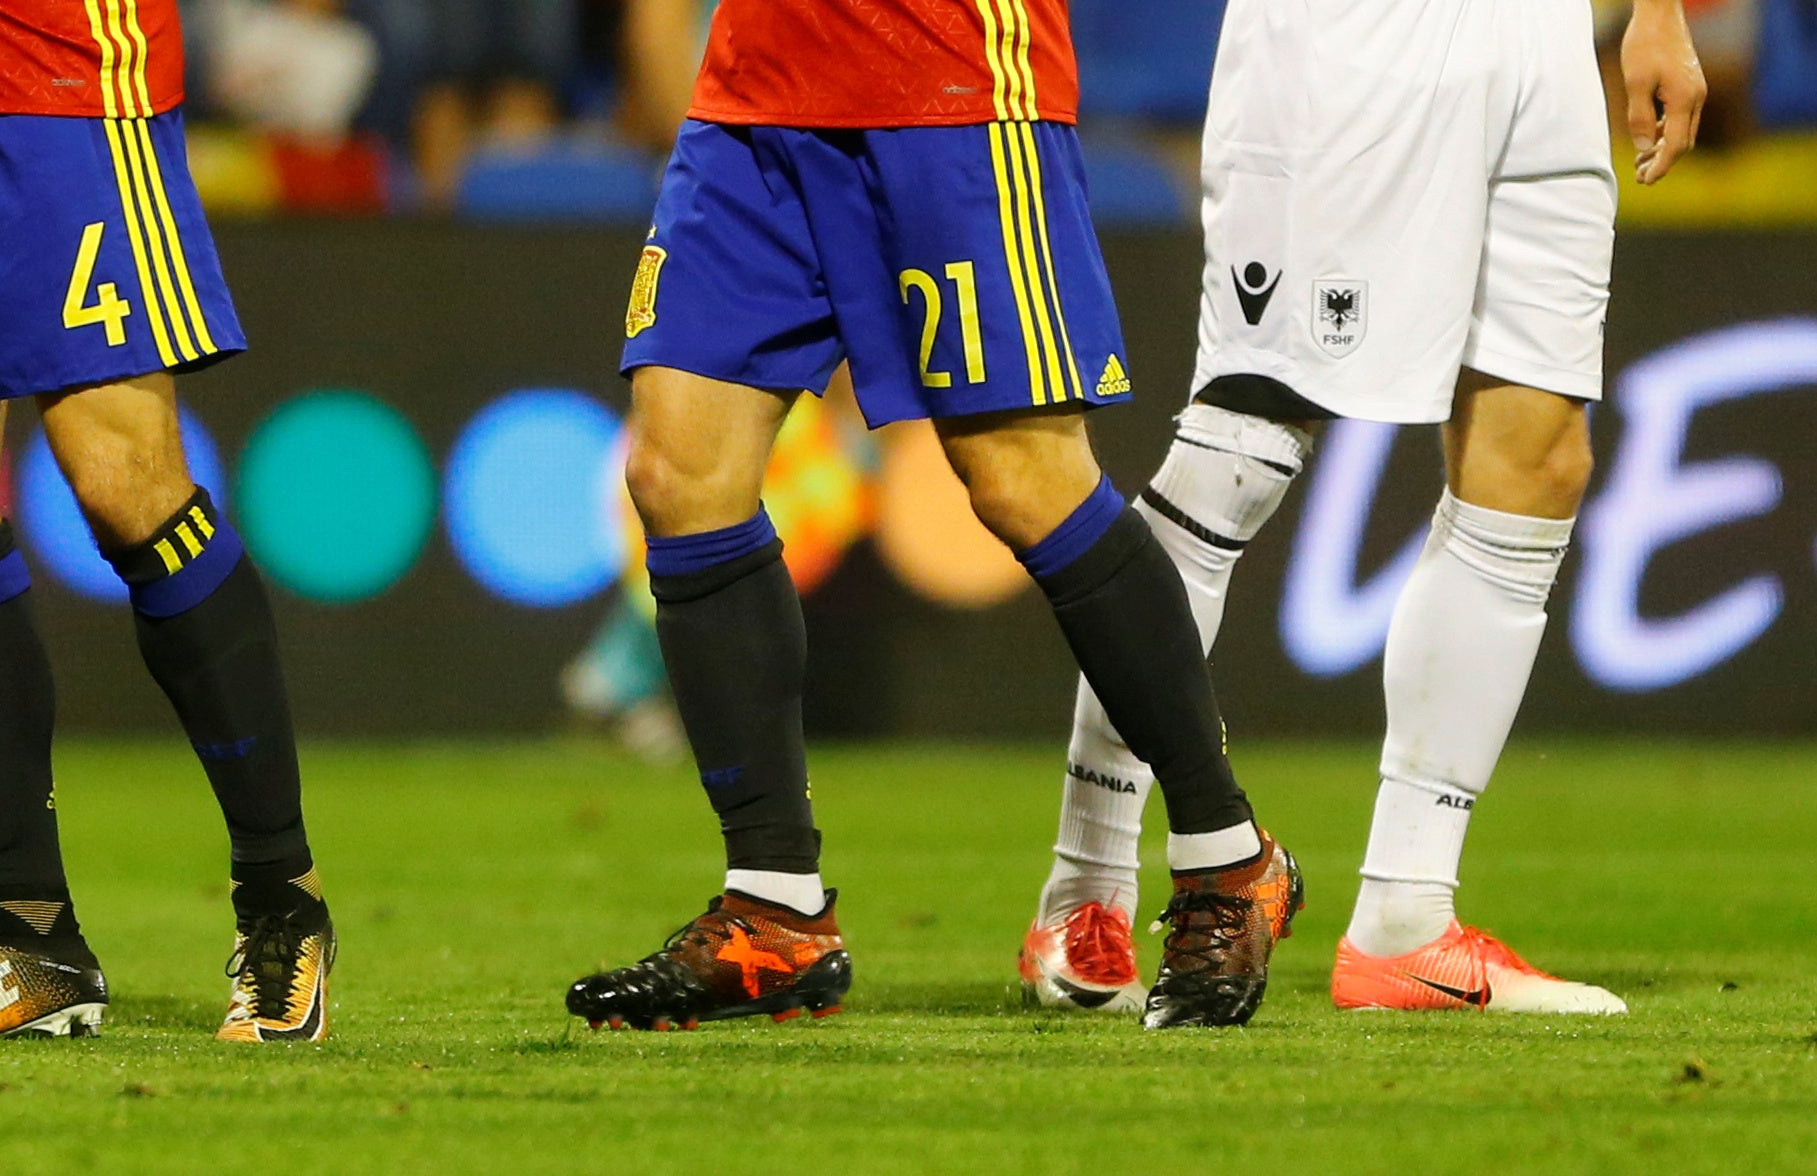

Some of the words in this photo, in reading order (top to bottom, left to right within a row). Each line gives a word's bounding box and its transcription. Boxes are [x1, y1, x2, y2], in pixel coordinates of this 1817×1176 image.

[61, 220, 132, 348] 4
[898, 259, 987, 389] 21
[1322, 333, 1355, 346] FSHF
[1095, 378, 1132, 397] adidas
[1067, 760, 1137, 796] LBANIA
